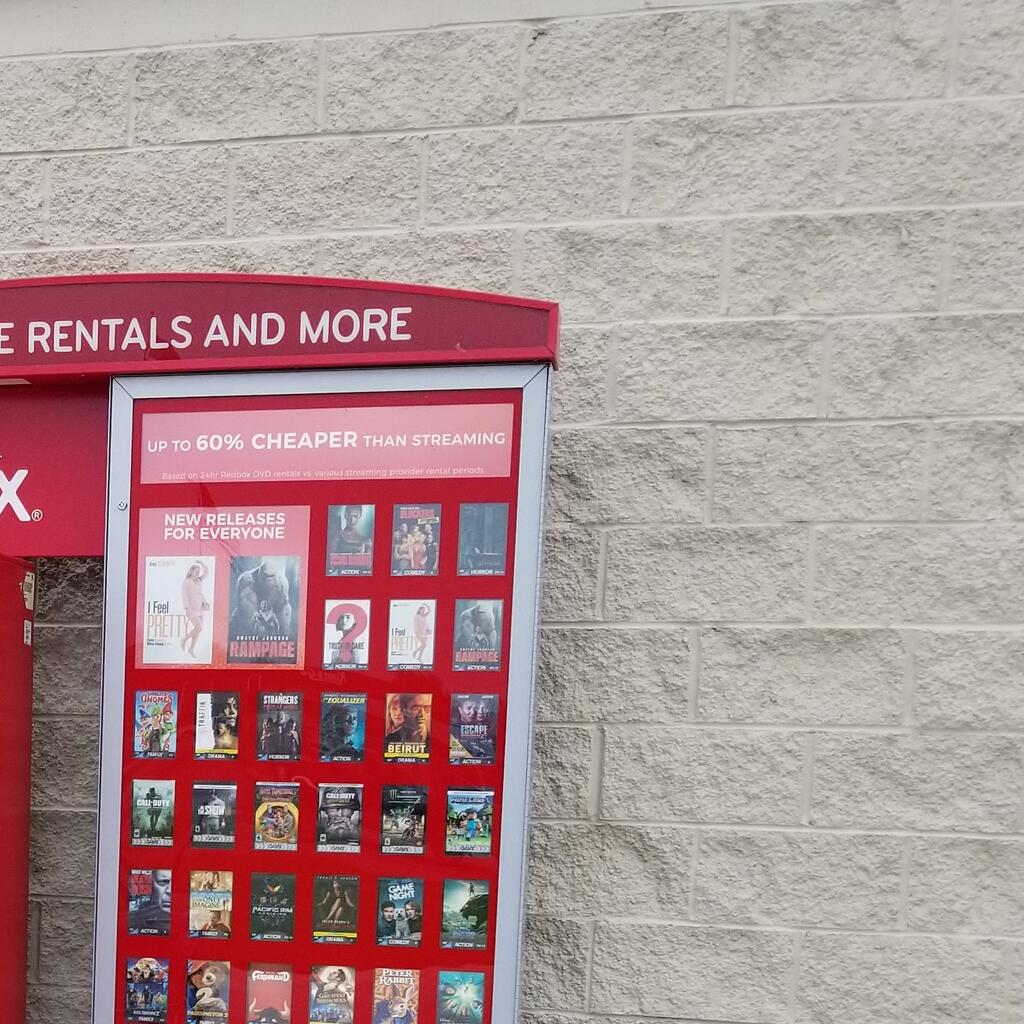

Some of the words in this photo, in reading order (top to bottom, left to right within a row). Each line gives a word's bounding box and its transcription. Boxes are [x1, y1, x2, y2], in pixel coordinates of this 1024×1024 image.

[27, 315, 193, 355] RENTALS
[203, 312, 284, 348] AND
[299, 306, 412, 344] MORE
[147, 440, 168, 452] UP
[171, 439, 192, 452] TO
[195, 433, 244, 451] 60%
[251, 431, 358, 449] CHEAPER
[362, 434, 407, 448] THAN
[411, 432, 505, 447] STREAMING
[161, 471, 186, 480] Based
[199, 471, 217, 479] 24hr
[220, 471, 250, 479] Redbox
[253, 470, 272, 478] DVD
[273, 470, 301, 478] rentals
[346, 468, 386, 477] streaming
[389, 467, 423, 476] provider
[426, 466, 451, 475] rental
[165, 514, 201, 526] NEW
[206, 513, 285, 525] RELEASES
[165, 528, 195, 540] FOR
[200, 527, 284, 540] EVERYONE
[148, 601, 151, 614] I
[153, 601, 169, 614] Feel
[148, 615, 190, 638] PRETTY
[230, 641, 295, 658] RAMPAGE
[264, 696, 299, 705] STRANGERS
[327, 697, 366, 705] EQUALIZER
[460, 724, 488, 735] ESCAPE
[388, 743, 426, 753] BEIRUT
[204, 805, 225, 816] SHOW
[388, 883, 414, 893] GAME
[388, 891, 415, 901] NIGHT
[252, 906, 278, 914] PACIFIC
[252, 970, 290, 981] FERDINAND
[382, 969, 413, 977] PETER
[379, 976, 415, 985] RABBIT
